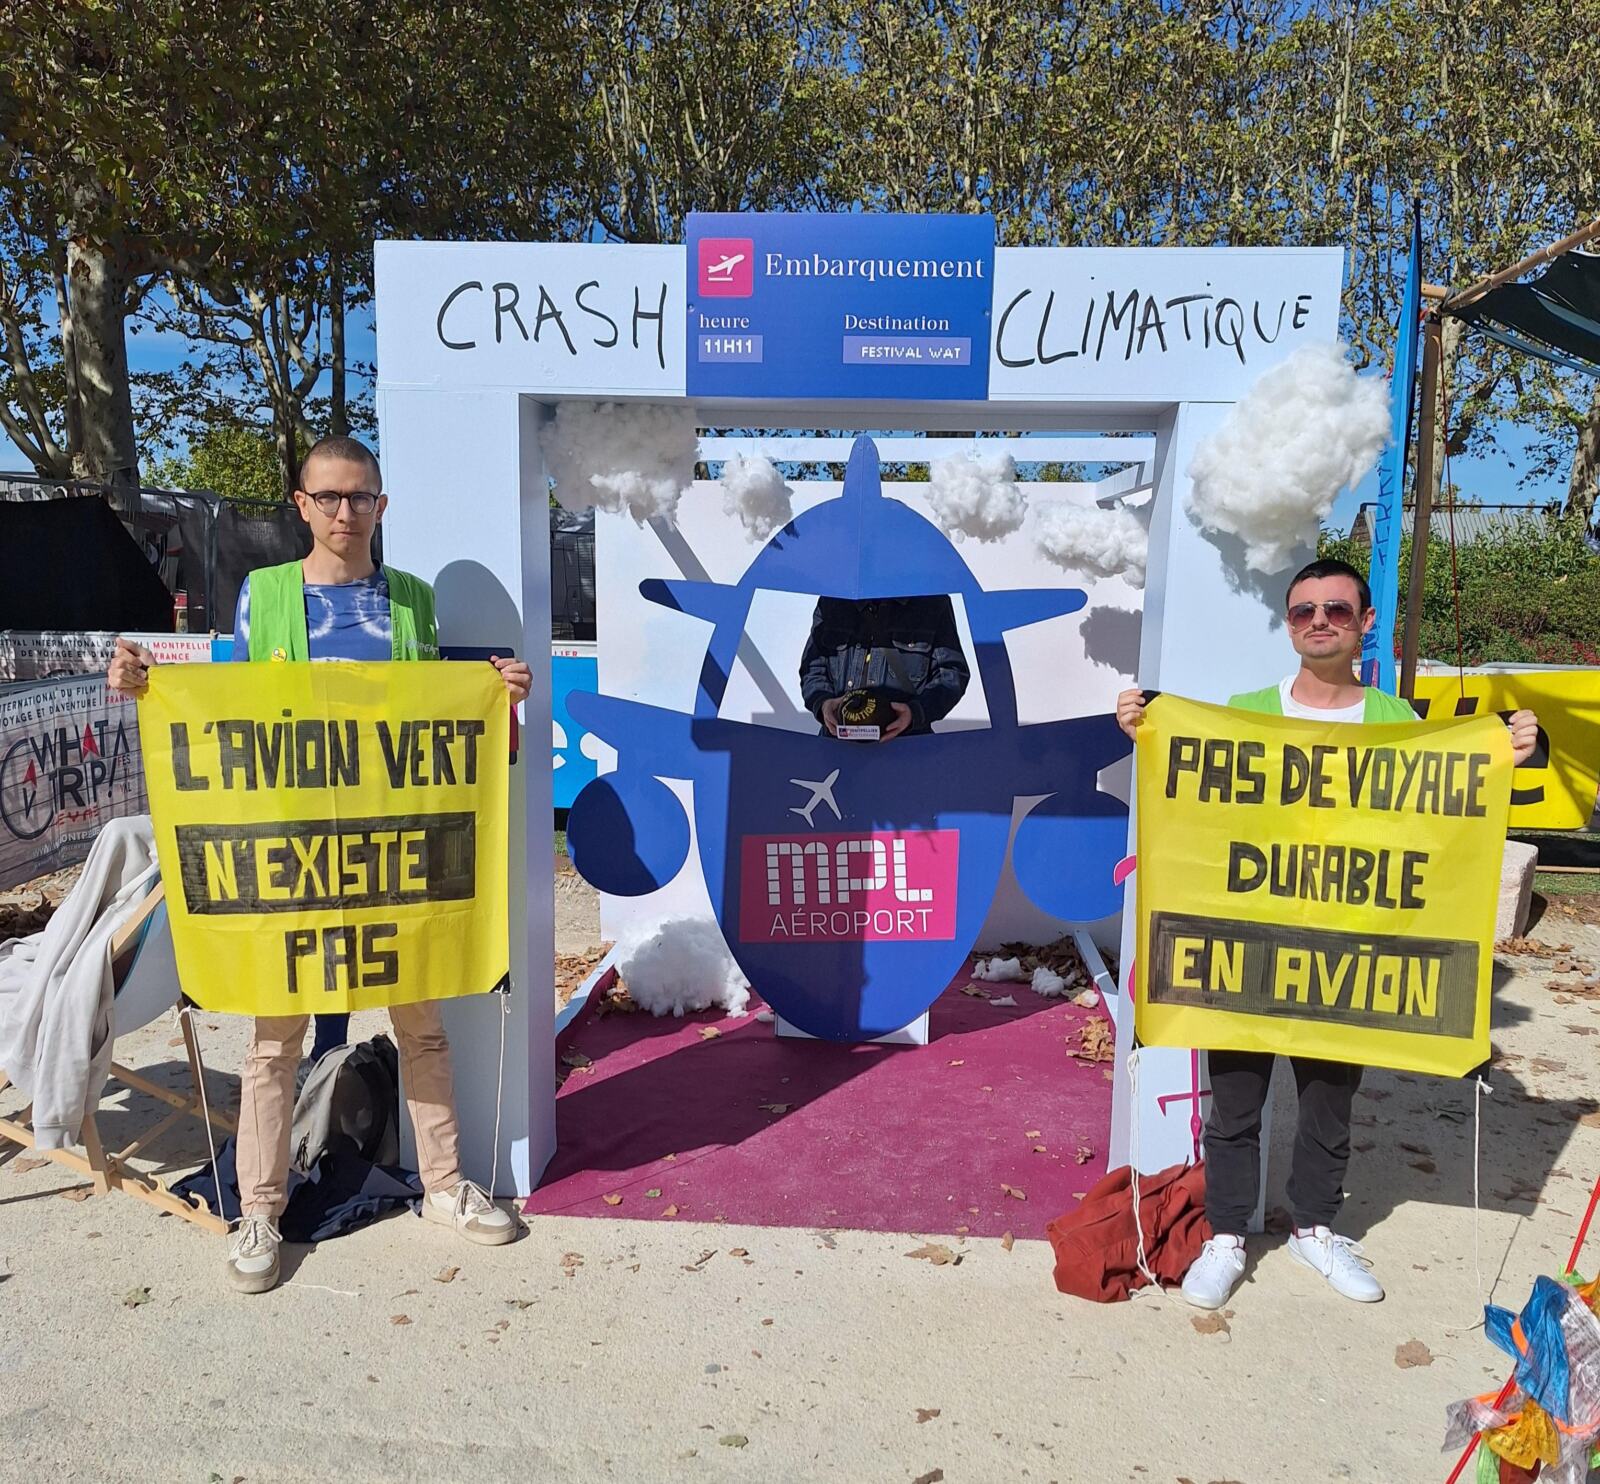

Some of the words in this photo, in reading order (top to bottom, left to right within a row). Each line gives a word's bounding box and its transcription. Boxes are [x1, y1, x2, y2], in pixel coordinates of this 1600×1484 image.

[765, 253, 985, 282] Embarquement
[437, 280, 668, 369] CRASH
[699, 314, 750, 329] heure
[844, 314, 950, 331] Destination
[704, 339, 753, 353] 11H11
[861, 346, 923, 359] FESTIVAL
[928, 347, 961, 359] WAT
[32, 639, 100, 648] INTERNATIONAL
[153, 641, 210, 650] MONTPELLIE
[37, 650, 73, 658] VOYAGE
[153, 652, 190, 661] FRANCE
[60, 688, 73, 698] DU
[76, 684, 97, 698] FILM
[0, 711, 33, 727] OYAGE
[36, 708, 45, 718] ET
[375, 719, 485, 789] VERT
[1165, 736, 1266, 805] PAS
[1280, 743, 1338, 808] DE
[1348, 746, 1492, 817] VOYAGE
[204, 830, 427, 902] N'EXISTE
[1227, 841, 1430, 909] DURABLE
[770, 907, 934, 937] AÉROPORT
[284, 923, 399, 994] PAS
[1172, 937, 1245, 993] EN
